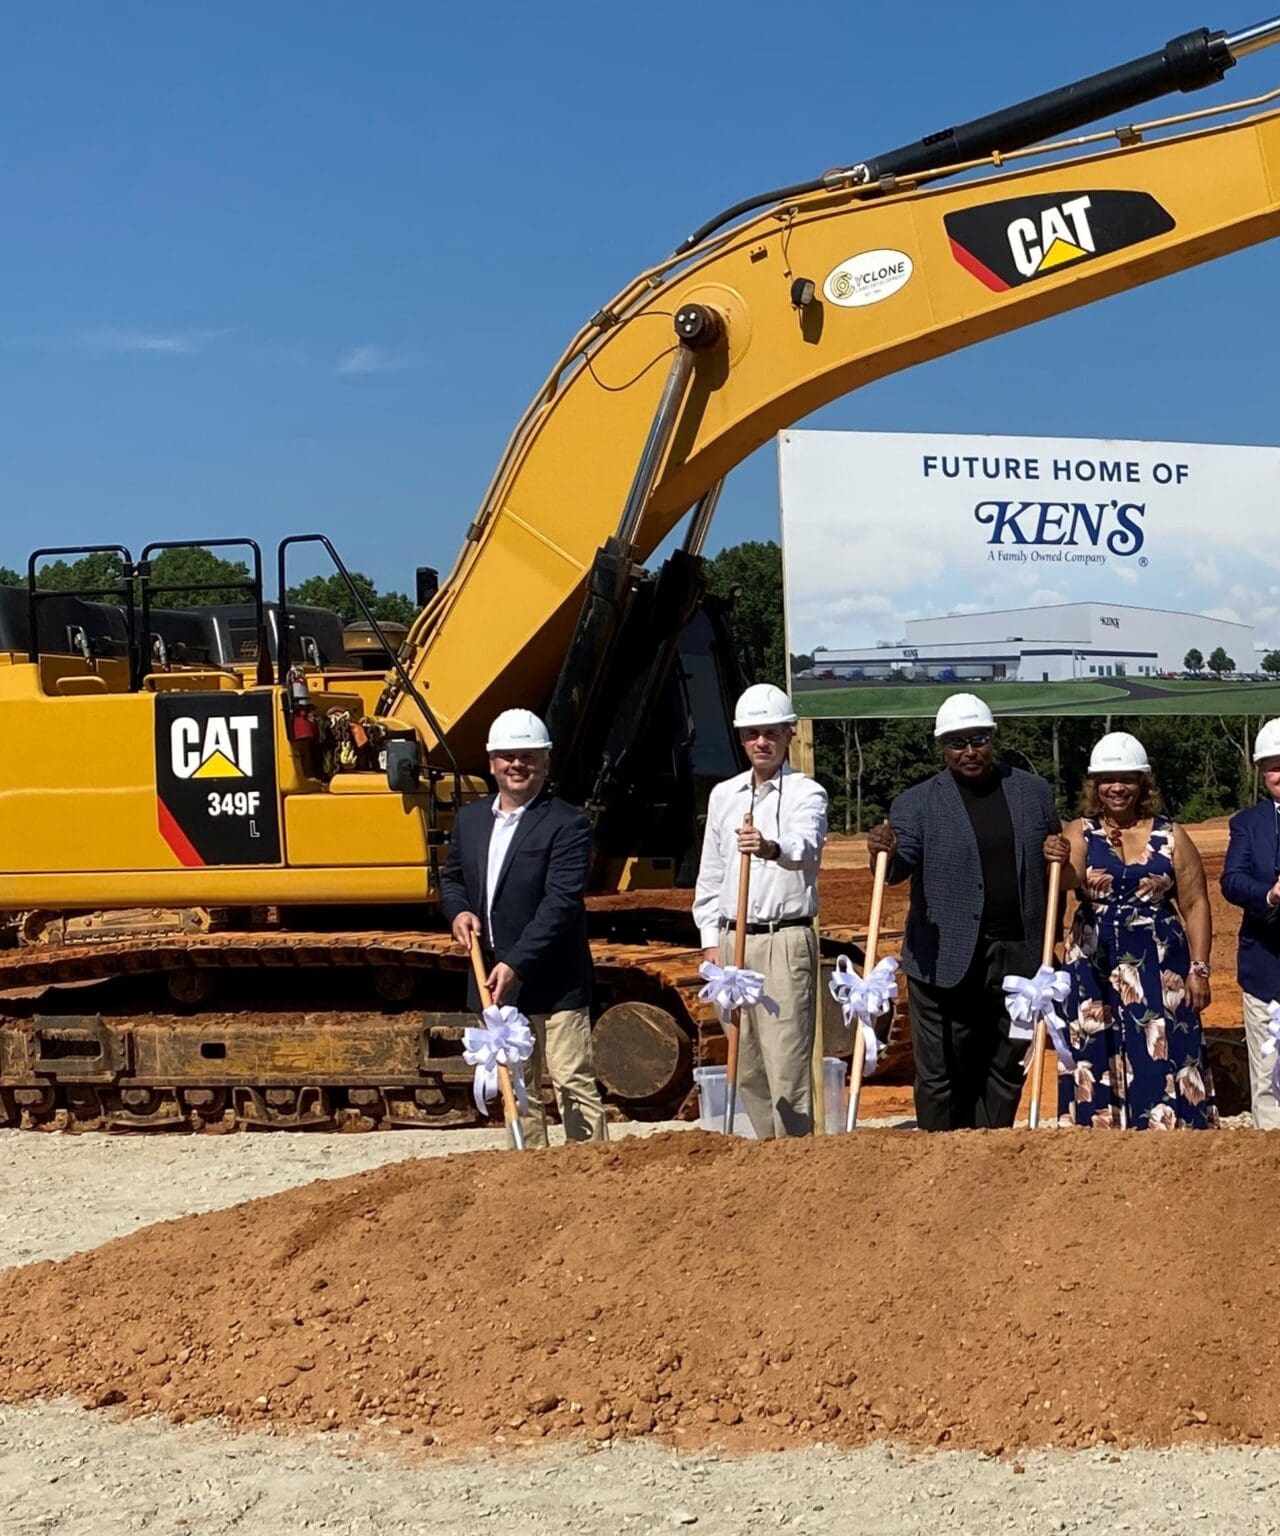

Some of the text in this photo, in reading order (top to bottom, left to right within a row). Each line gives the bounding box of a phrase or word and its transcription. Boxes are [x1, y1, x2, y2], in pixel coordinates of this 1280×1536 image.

[1007, 195, 1096, 277] CAT
[923, 456, 1189, 484] FUTURE HOME OF
[974, 500, 1146, 557] KEN'S
[987, 550, 1106, 565] A Family Owned Company
[170, 715, 259, 779] CAT
[207, 791, 261, 816] 349F
[250, 819, 261, 838] L
